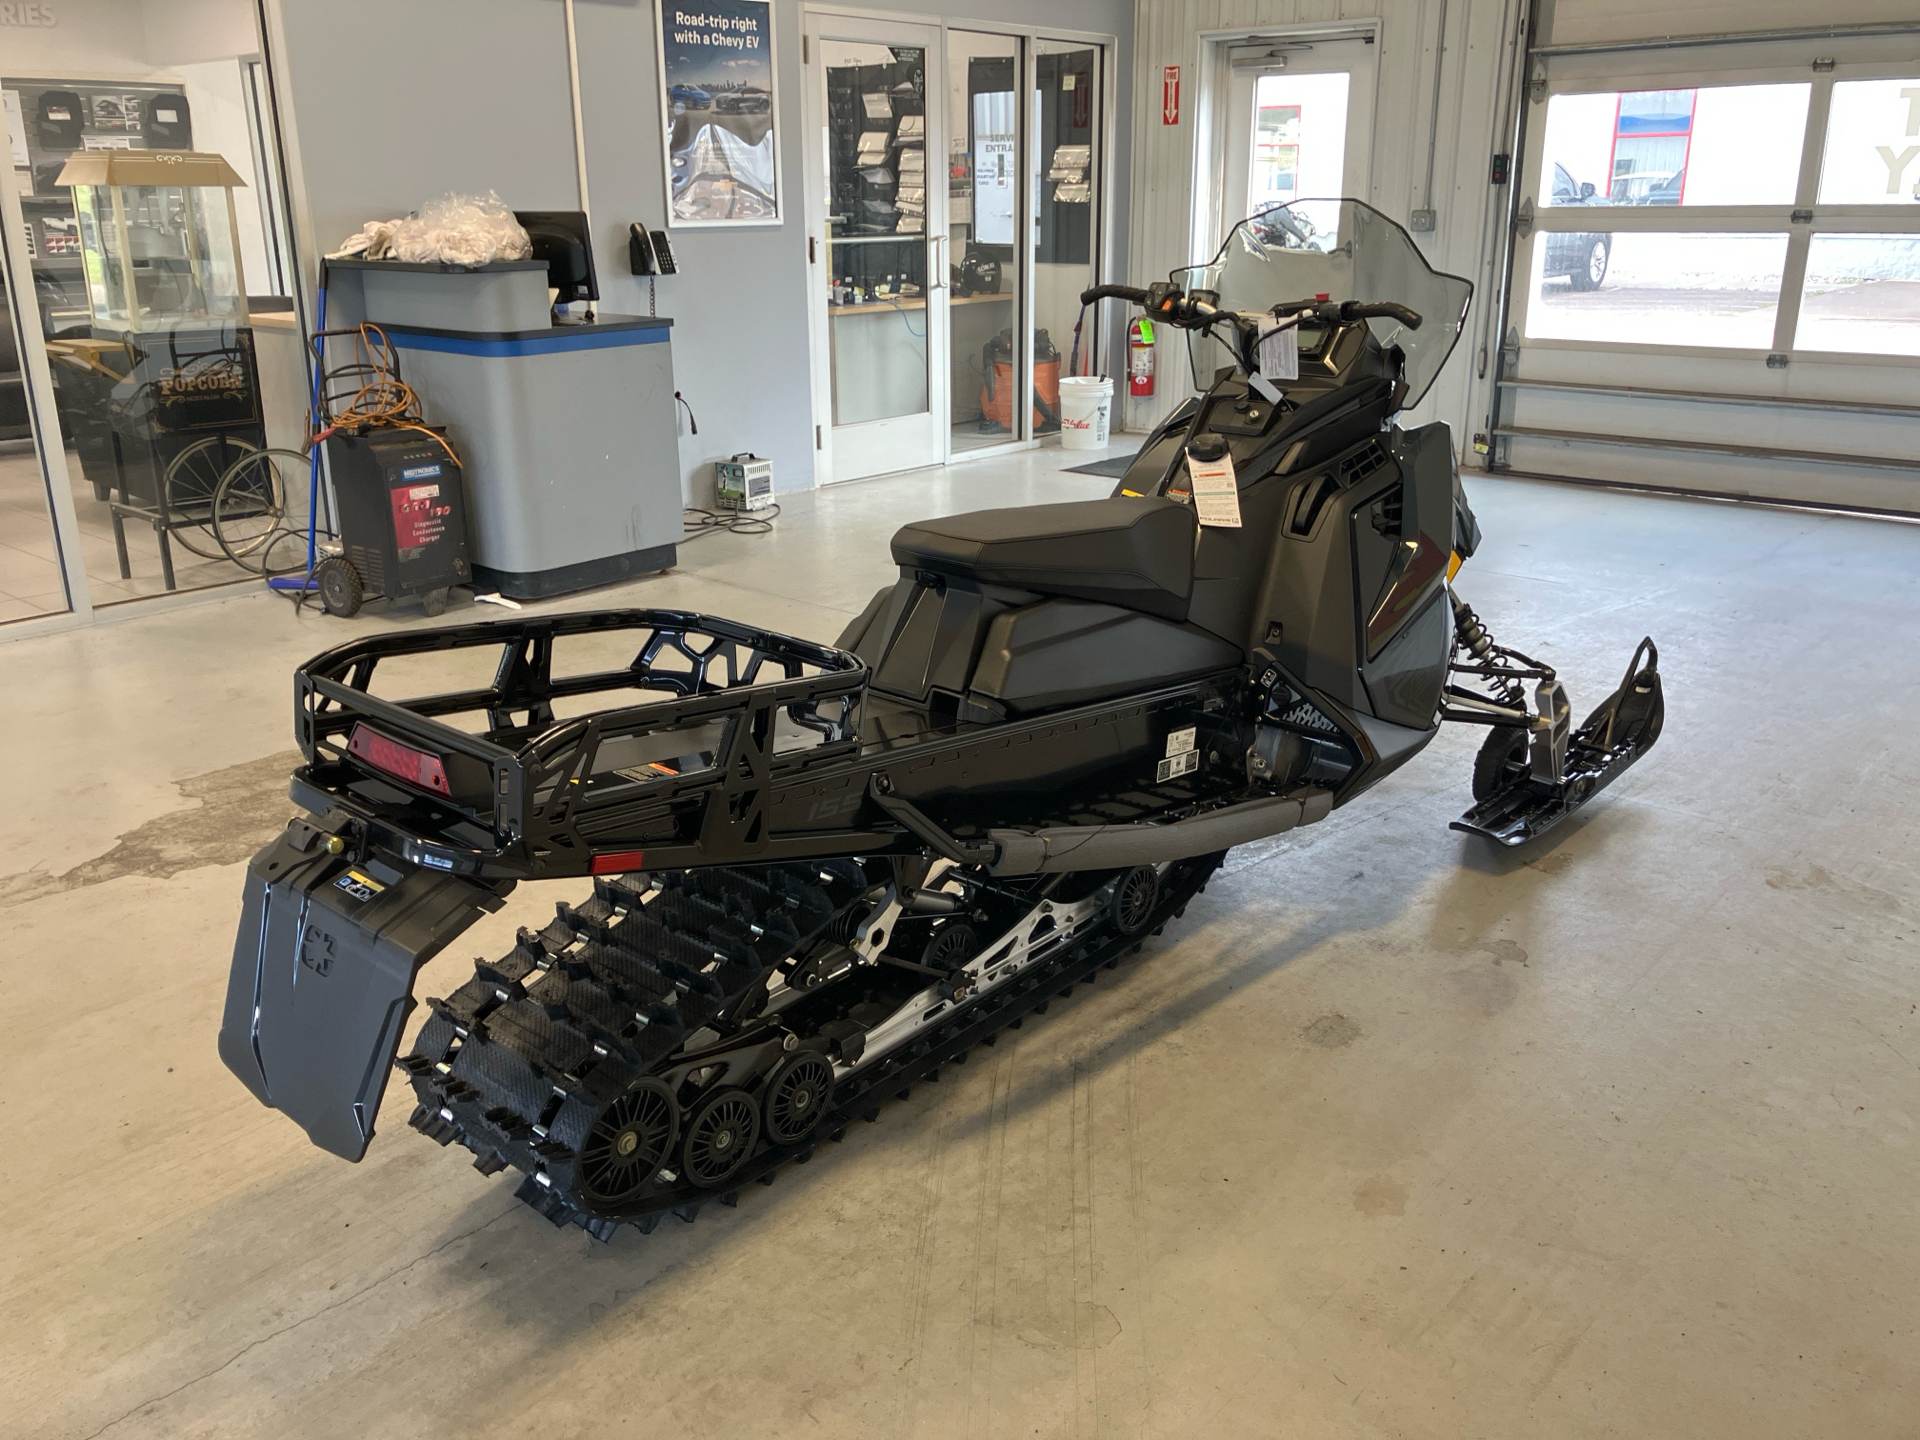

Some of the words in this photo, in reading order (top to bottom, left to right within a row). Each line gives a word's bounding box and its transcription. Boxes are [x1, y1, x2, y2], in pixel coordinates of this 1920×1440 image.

[675, 11, 729, 31] Road-trip
[731, 16, 757, 32] right
[674, 30, 701, 44] with
[703, 34, 710, 45] a
[711, 32, 744, 50] Chevy
[746, 36, 759, 49] EV
[159, 372, 243, 395] POPCORN
[403, 465, 440, 477] MIDTRONICS
[414, 519, 442, 528] Diagnostic
[412, 526, 445, 536] Conductance
[419, 535, 440, 543] Charger
